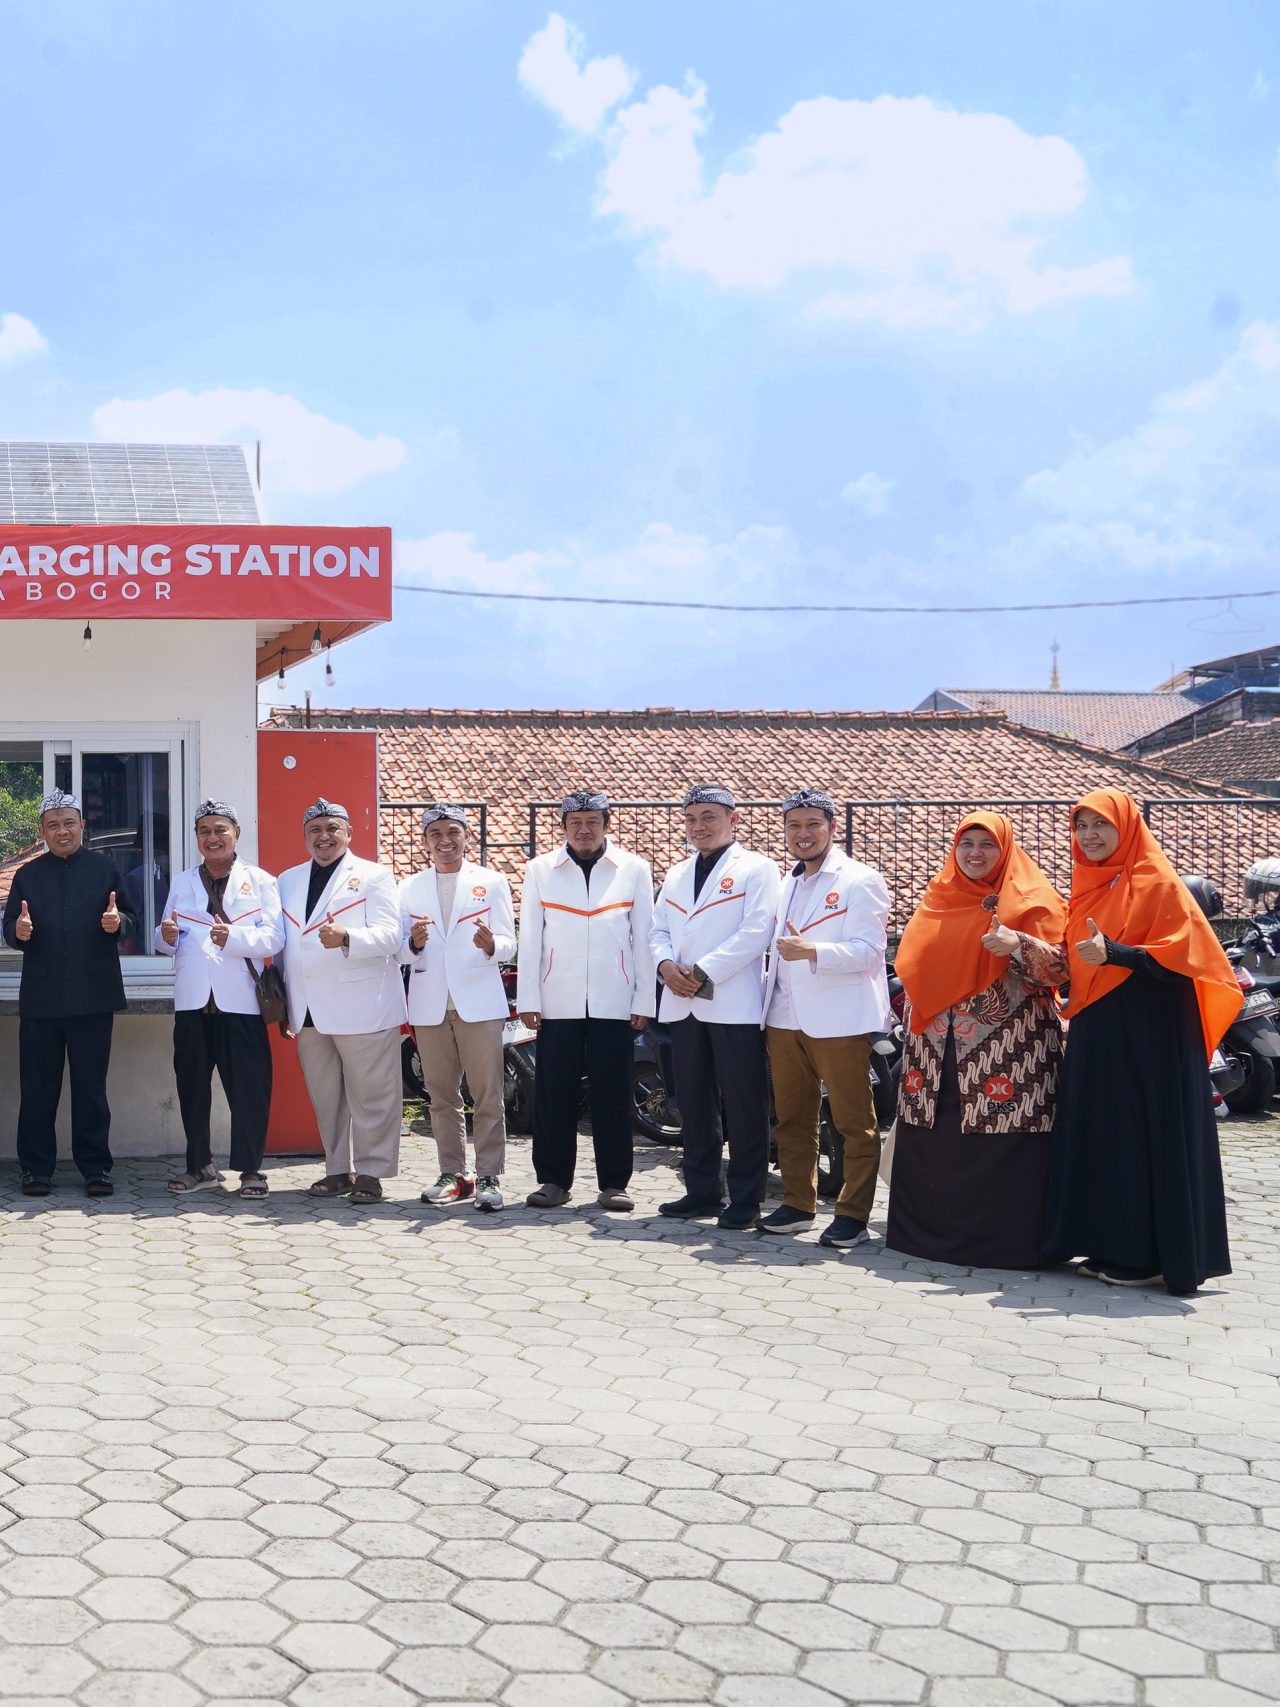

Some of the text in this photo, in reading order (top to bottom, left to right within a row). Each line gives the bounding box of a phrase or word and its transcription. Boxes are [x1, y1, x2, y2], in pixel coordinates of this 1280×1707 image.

[185, 544, 380, 578] STATION
[26, 582, 171, 600] BOGOR
[987, 1101, 1016, 1112] PKS
